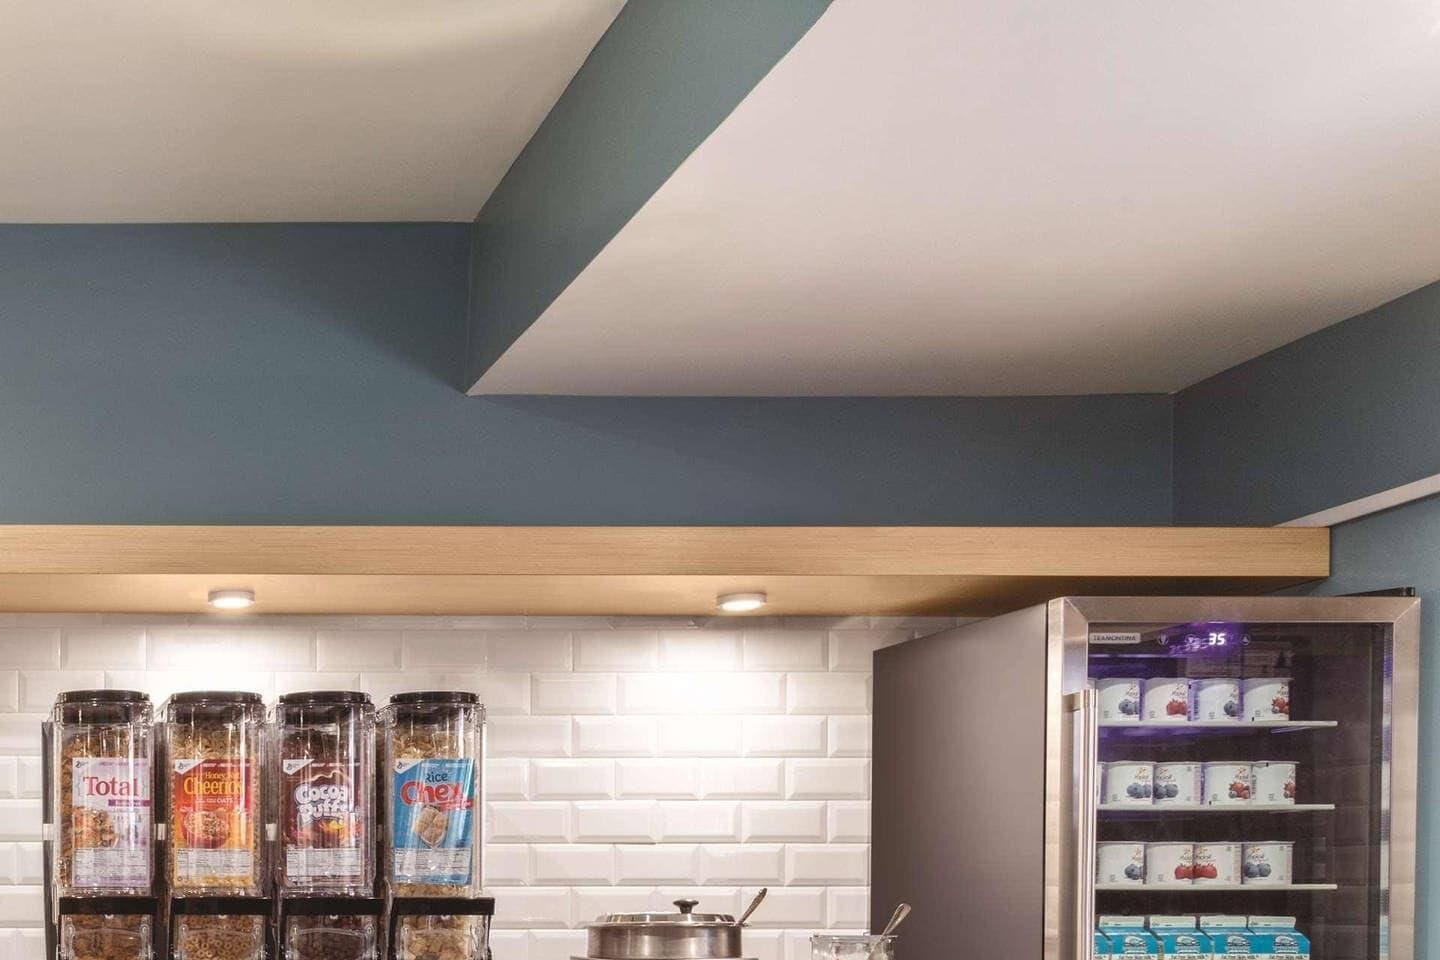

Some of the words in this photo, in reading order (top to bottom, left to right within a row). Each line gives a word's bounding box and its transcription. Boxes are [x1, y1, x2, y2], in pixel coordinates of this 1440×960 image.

[1208, 633, 1225, 645] 35
[83, 776, 139, 796] Total
[294, 784, 349, 805] Cocoa
